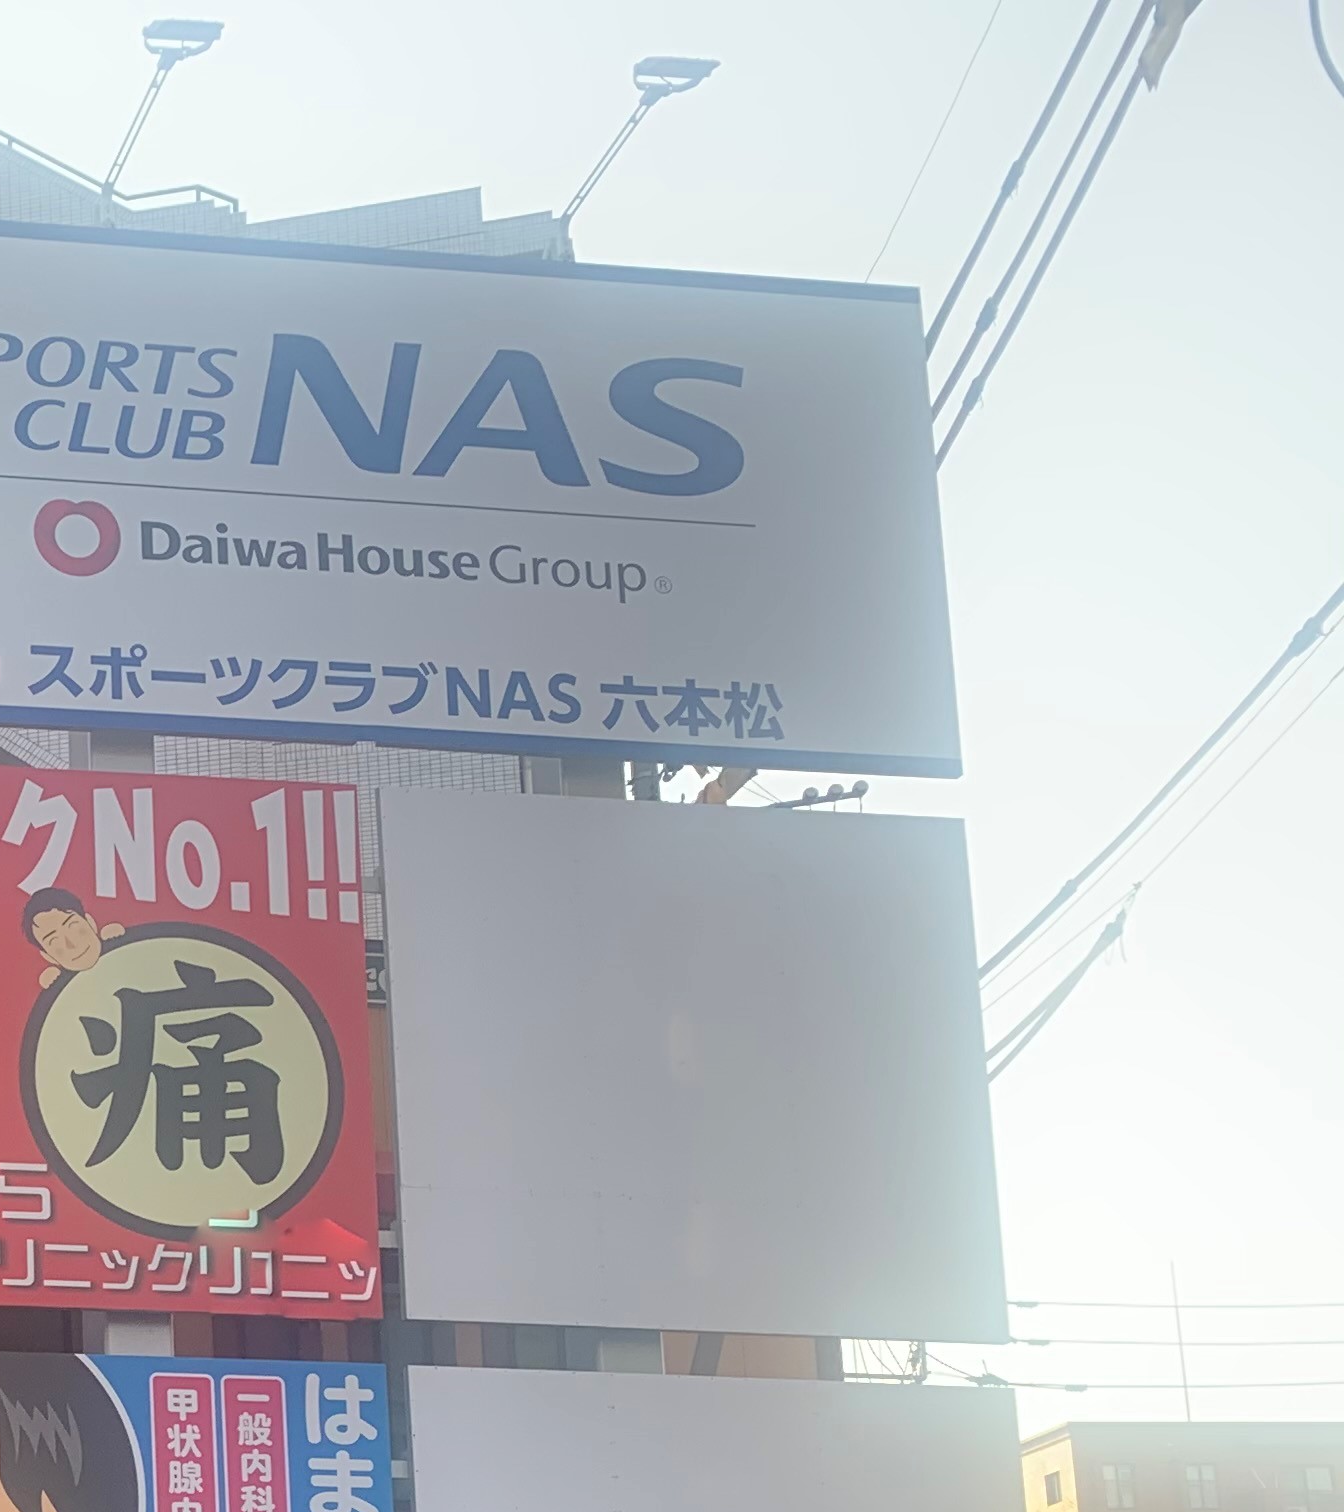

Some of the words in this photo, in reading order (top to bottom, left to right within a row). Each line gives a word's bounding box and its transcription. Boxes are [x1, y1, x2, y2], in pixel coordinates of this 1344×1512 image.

[13, 399, 225, 462] CLUB
[250, 332, 746, 497] NAS
[602, 676, 786, 742] 六本松
[71, 960, 285, 1185] 痛
